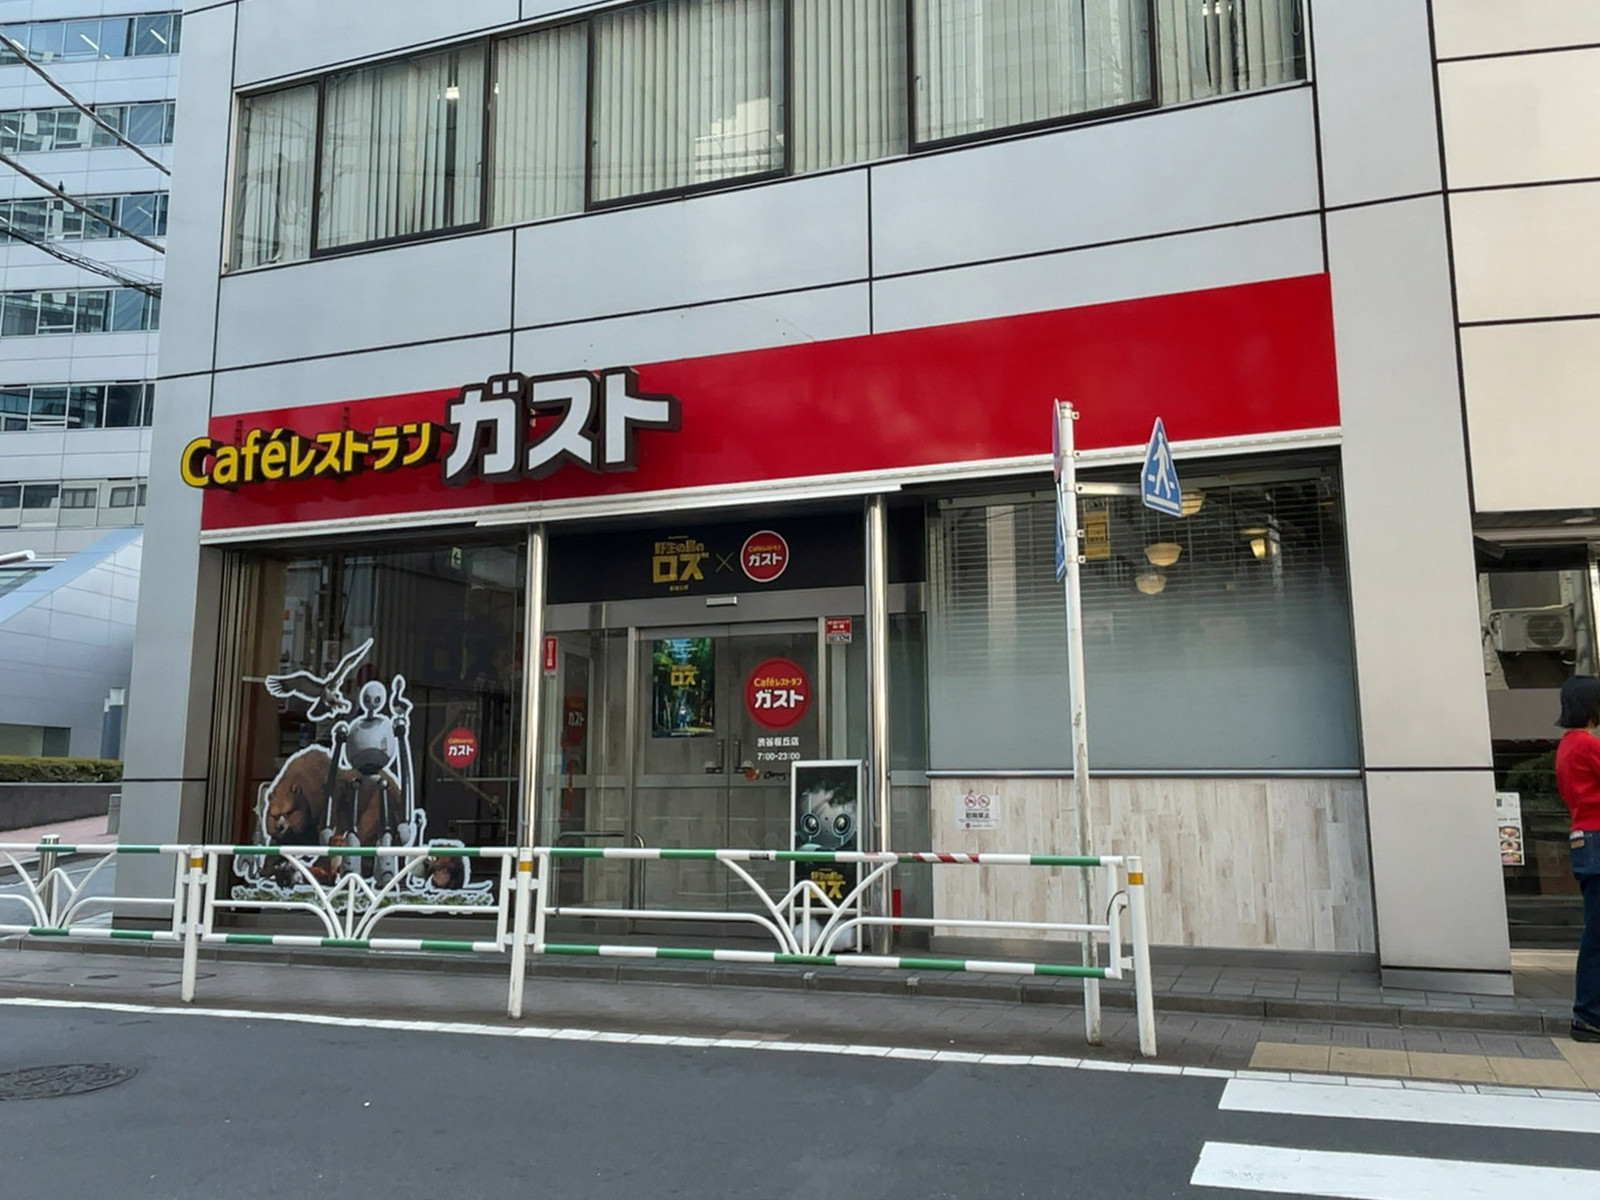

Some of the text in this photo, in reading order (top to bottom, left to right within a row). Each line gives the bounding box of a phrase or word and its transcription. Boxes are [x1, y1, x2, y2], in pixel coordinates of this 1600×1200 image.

[180, 371, 671, 488] Caféレストラン ガスト
[652, 552, 709, 583] ロズ
[748, 553, 783, 567] ガスト
[755, 689, 805, 708] ガスト
[448, 744, 475, 756] ガスト
